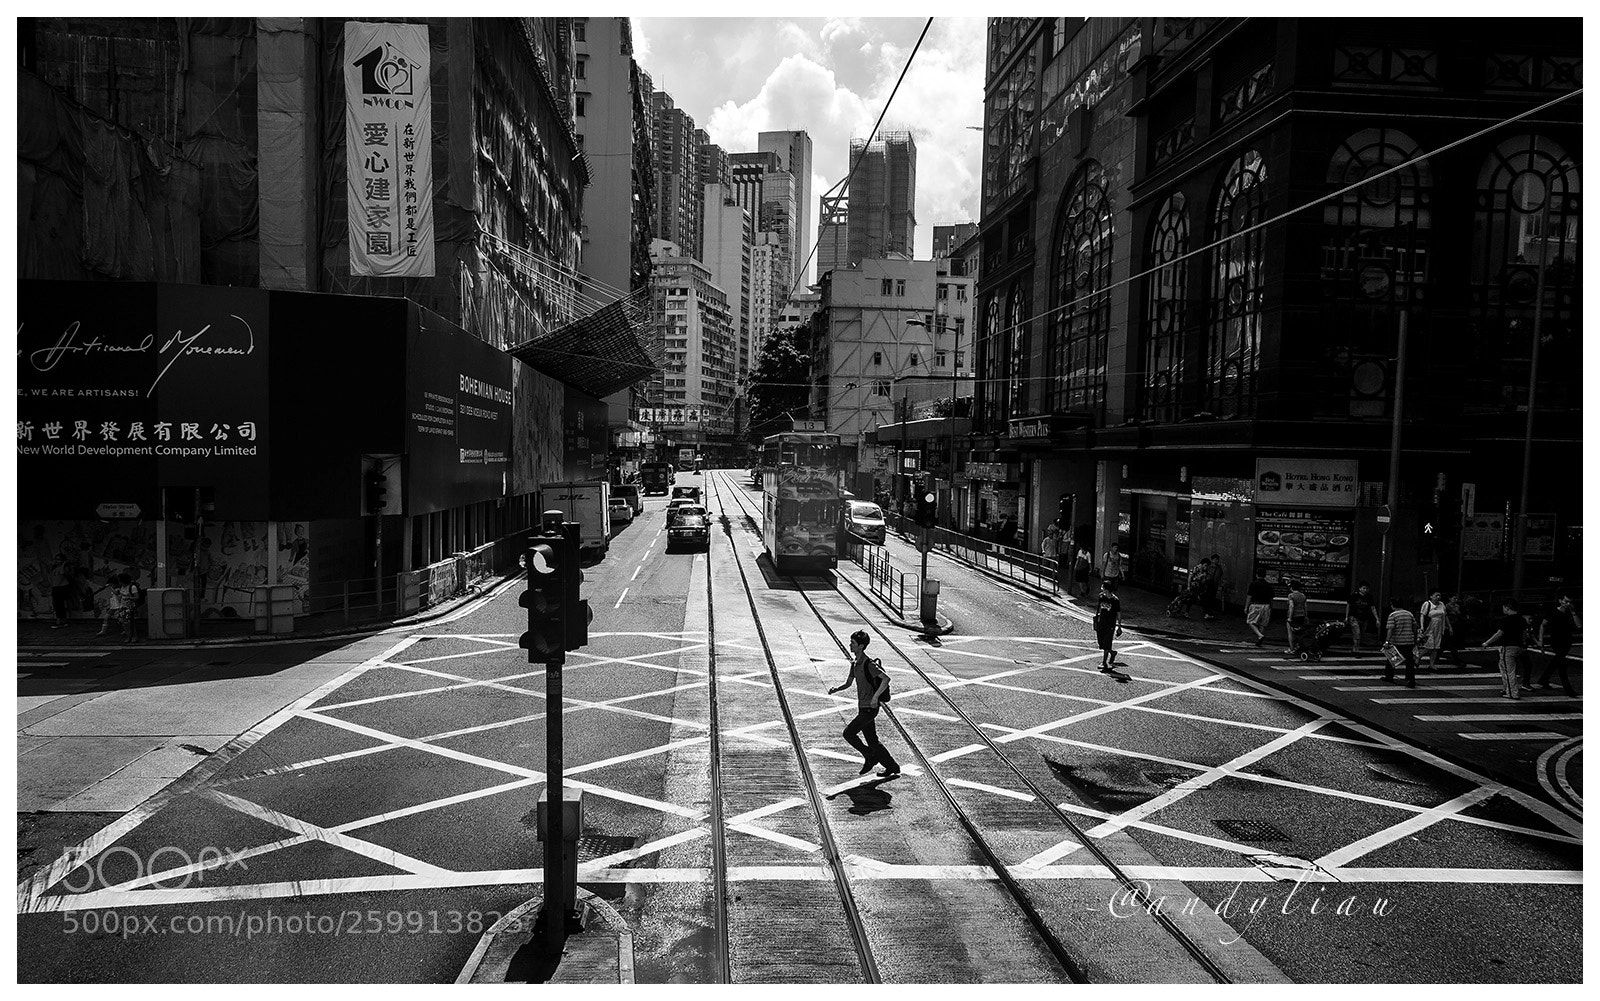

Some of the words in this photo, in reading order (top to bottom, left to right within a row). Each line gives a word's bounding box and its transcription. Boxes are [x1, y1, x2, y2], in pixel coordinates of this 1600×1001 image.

[363, 121, 392, 257] 愛心建家園
[401, 121, 418, 258] 在新世界我們都是工匠
[31, 388, 48, 397] WE
[51, 388, 74, 397] ARE
[77, 388, 140, 397] ARTISANS!
[459, 373, 494, 400] BOHEMIAN
[494, 387, 512, 405] HOUSE
[17, 420, 257, 443] 新世界發展有限公司
[803, 421, 816, 430] 13
[41, 444, 75, 455] World
[77, 444, 153, 458] Development
[154, 444, 212, 458] Company
[214, 445, 257, 456] Limited
[1285, 472, 1309, 481] HOTEL
[1310, 473, 1331, 481] HONG
[1333, 473, 1354, 482] KONG
